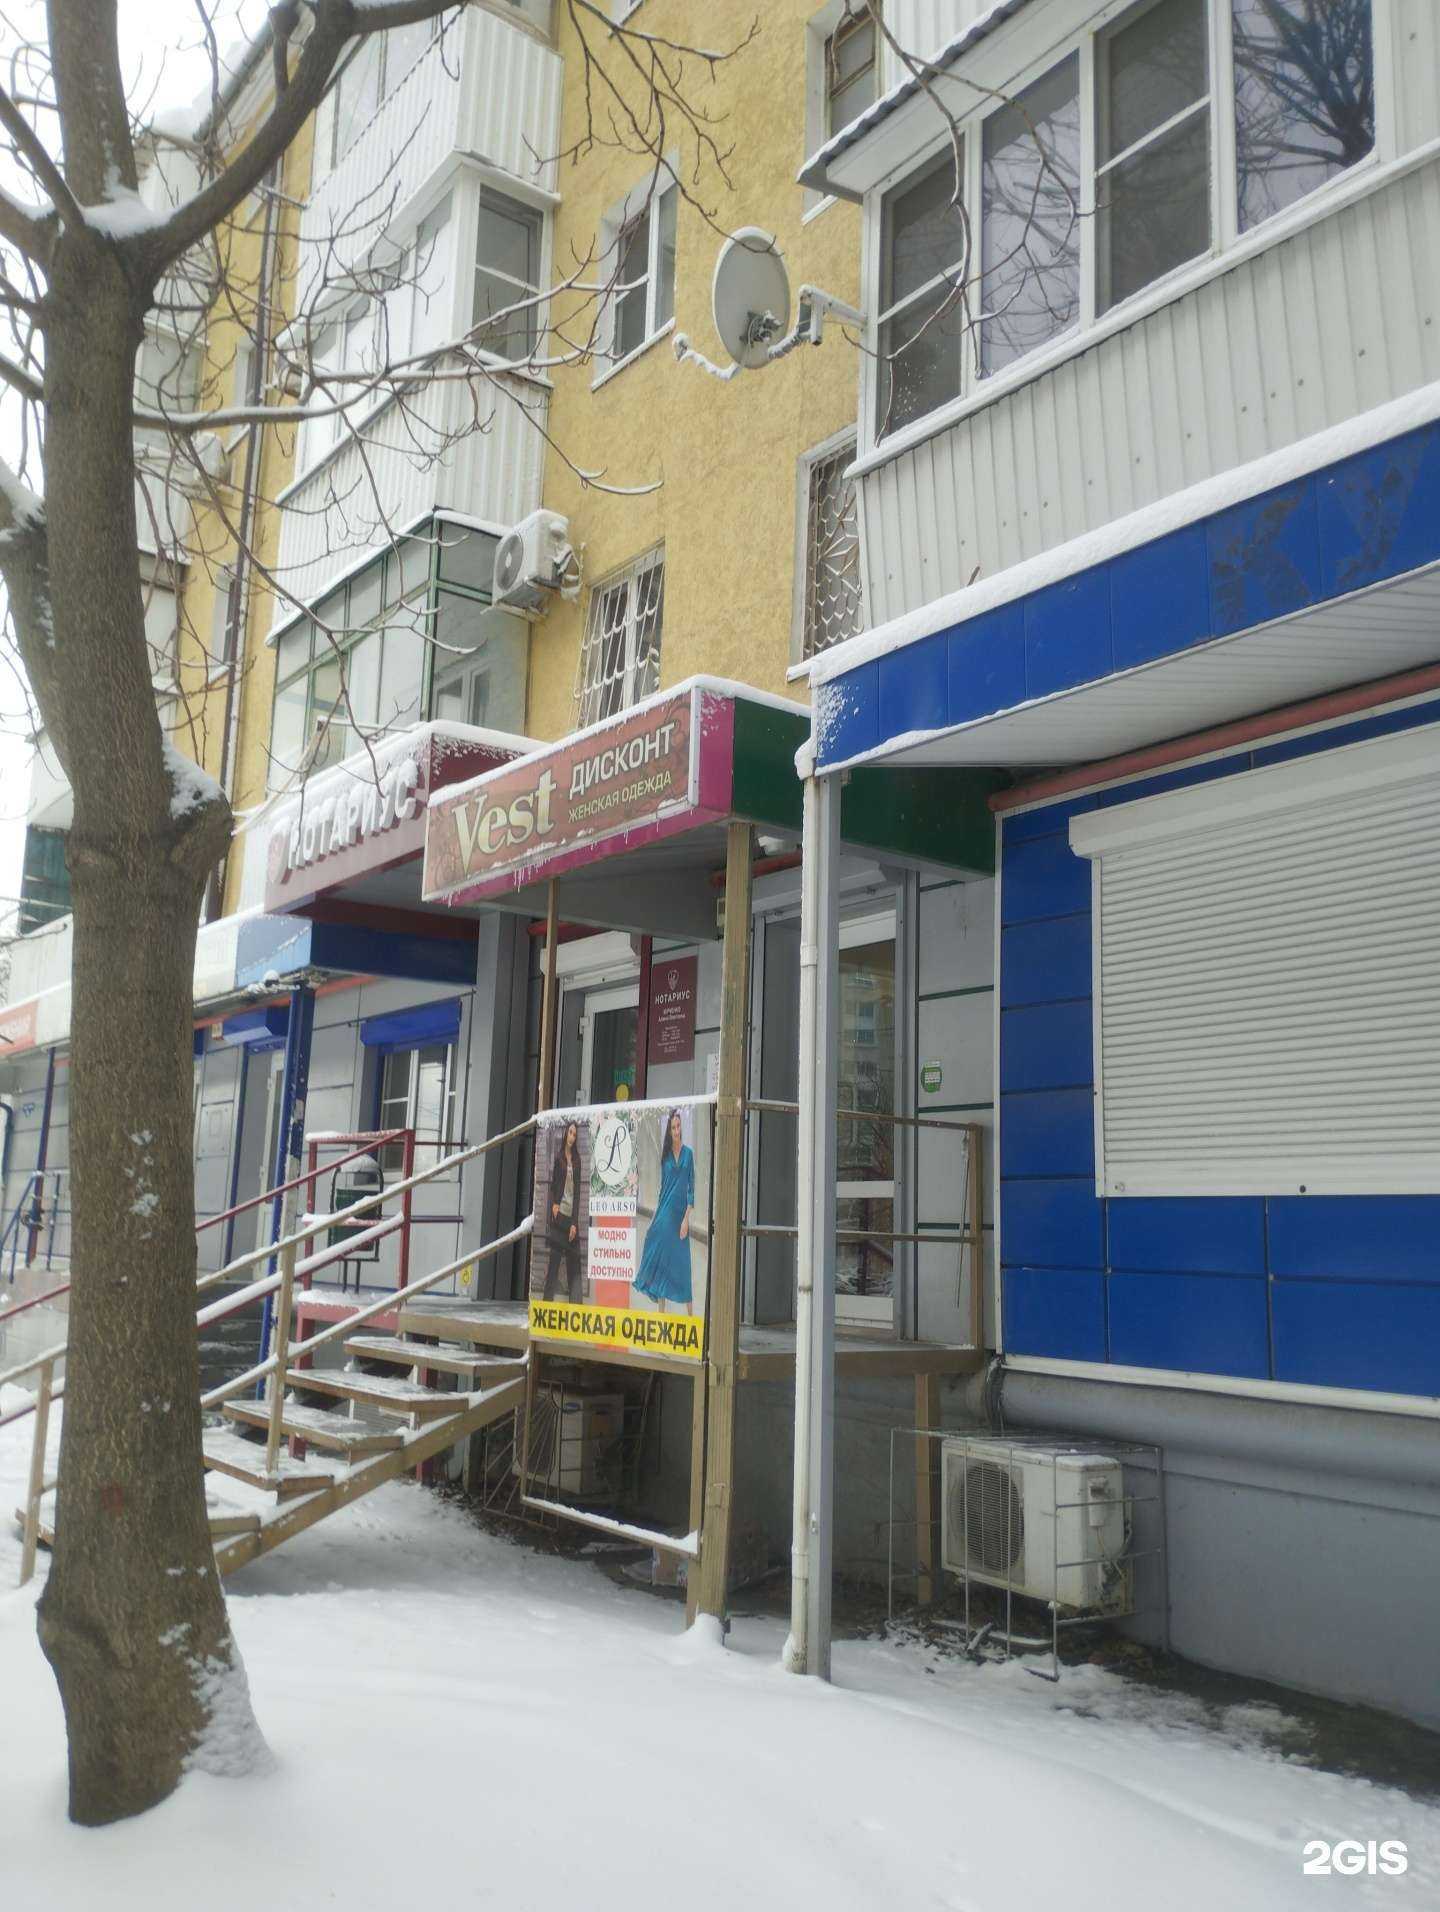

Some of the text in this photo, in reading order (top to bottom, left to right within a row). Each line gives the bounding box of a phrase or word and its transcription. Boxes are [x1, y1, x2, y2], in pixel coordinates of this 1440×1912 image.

[569, 722, 675, 800] ДИСКОНТ
[568, 770, 672, 824] ЖЕНСКАЯ ОДЕЖДА
[451, 769, 557, 878] Vest
[655, 990, 691, 1005] НОТАРИУС
[609, 1200, 635, 1212] ARSO
[598, 1229, 627, 1241] МОДНО
[593, 1248, 631, 1260] СТИЛЬНО
[590, 1265, 634, 1278] ДОСТУПНО
[532, 1307, 699, 1352] ЖЕНСКАЯ ОДЕЖДА
